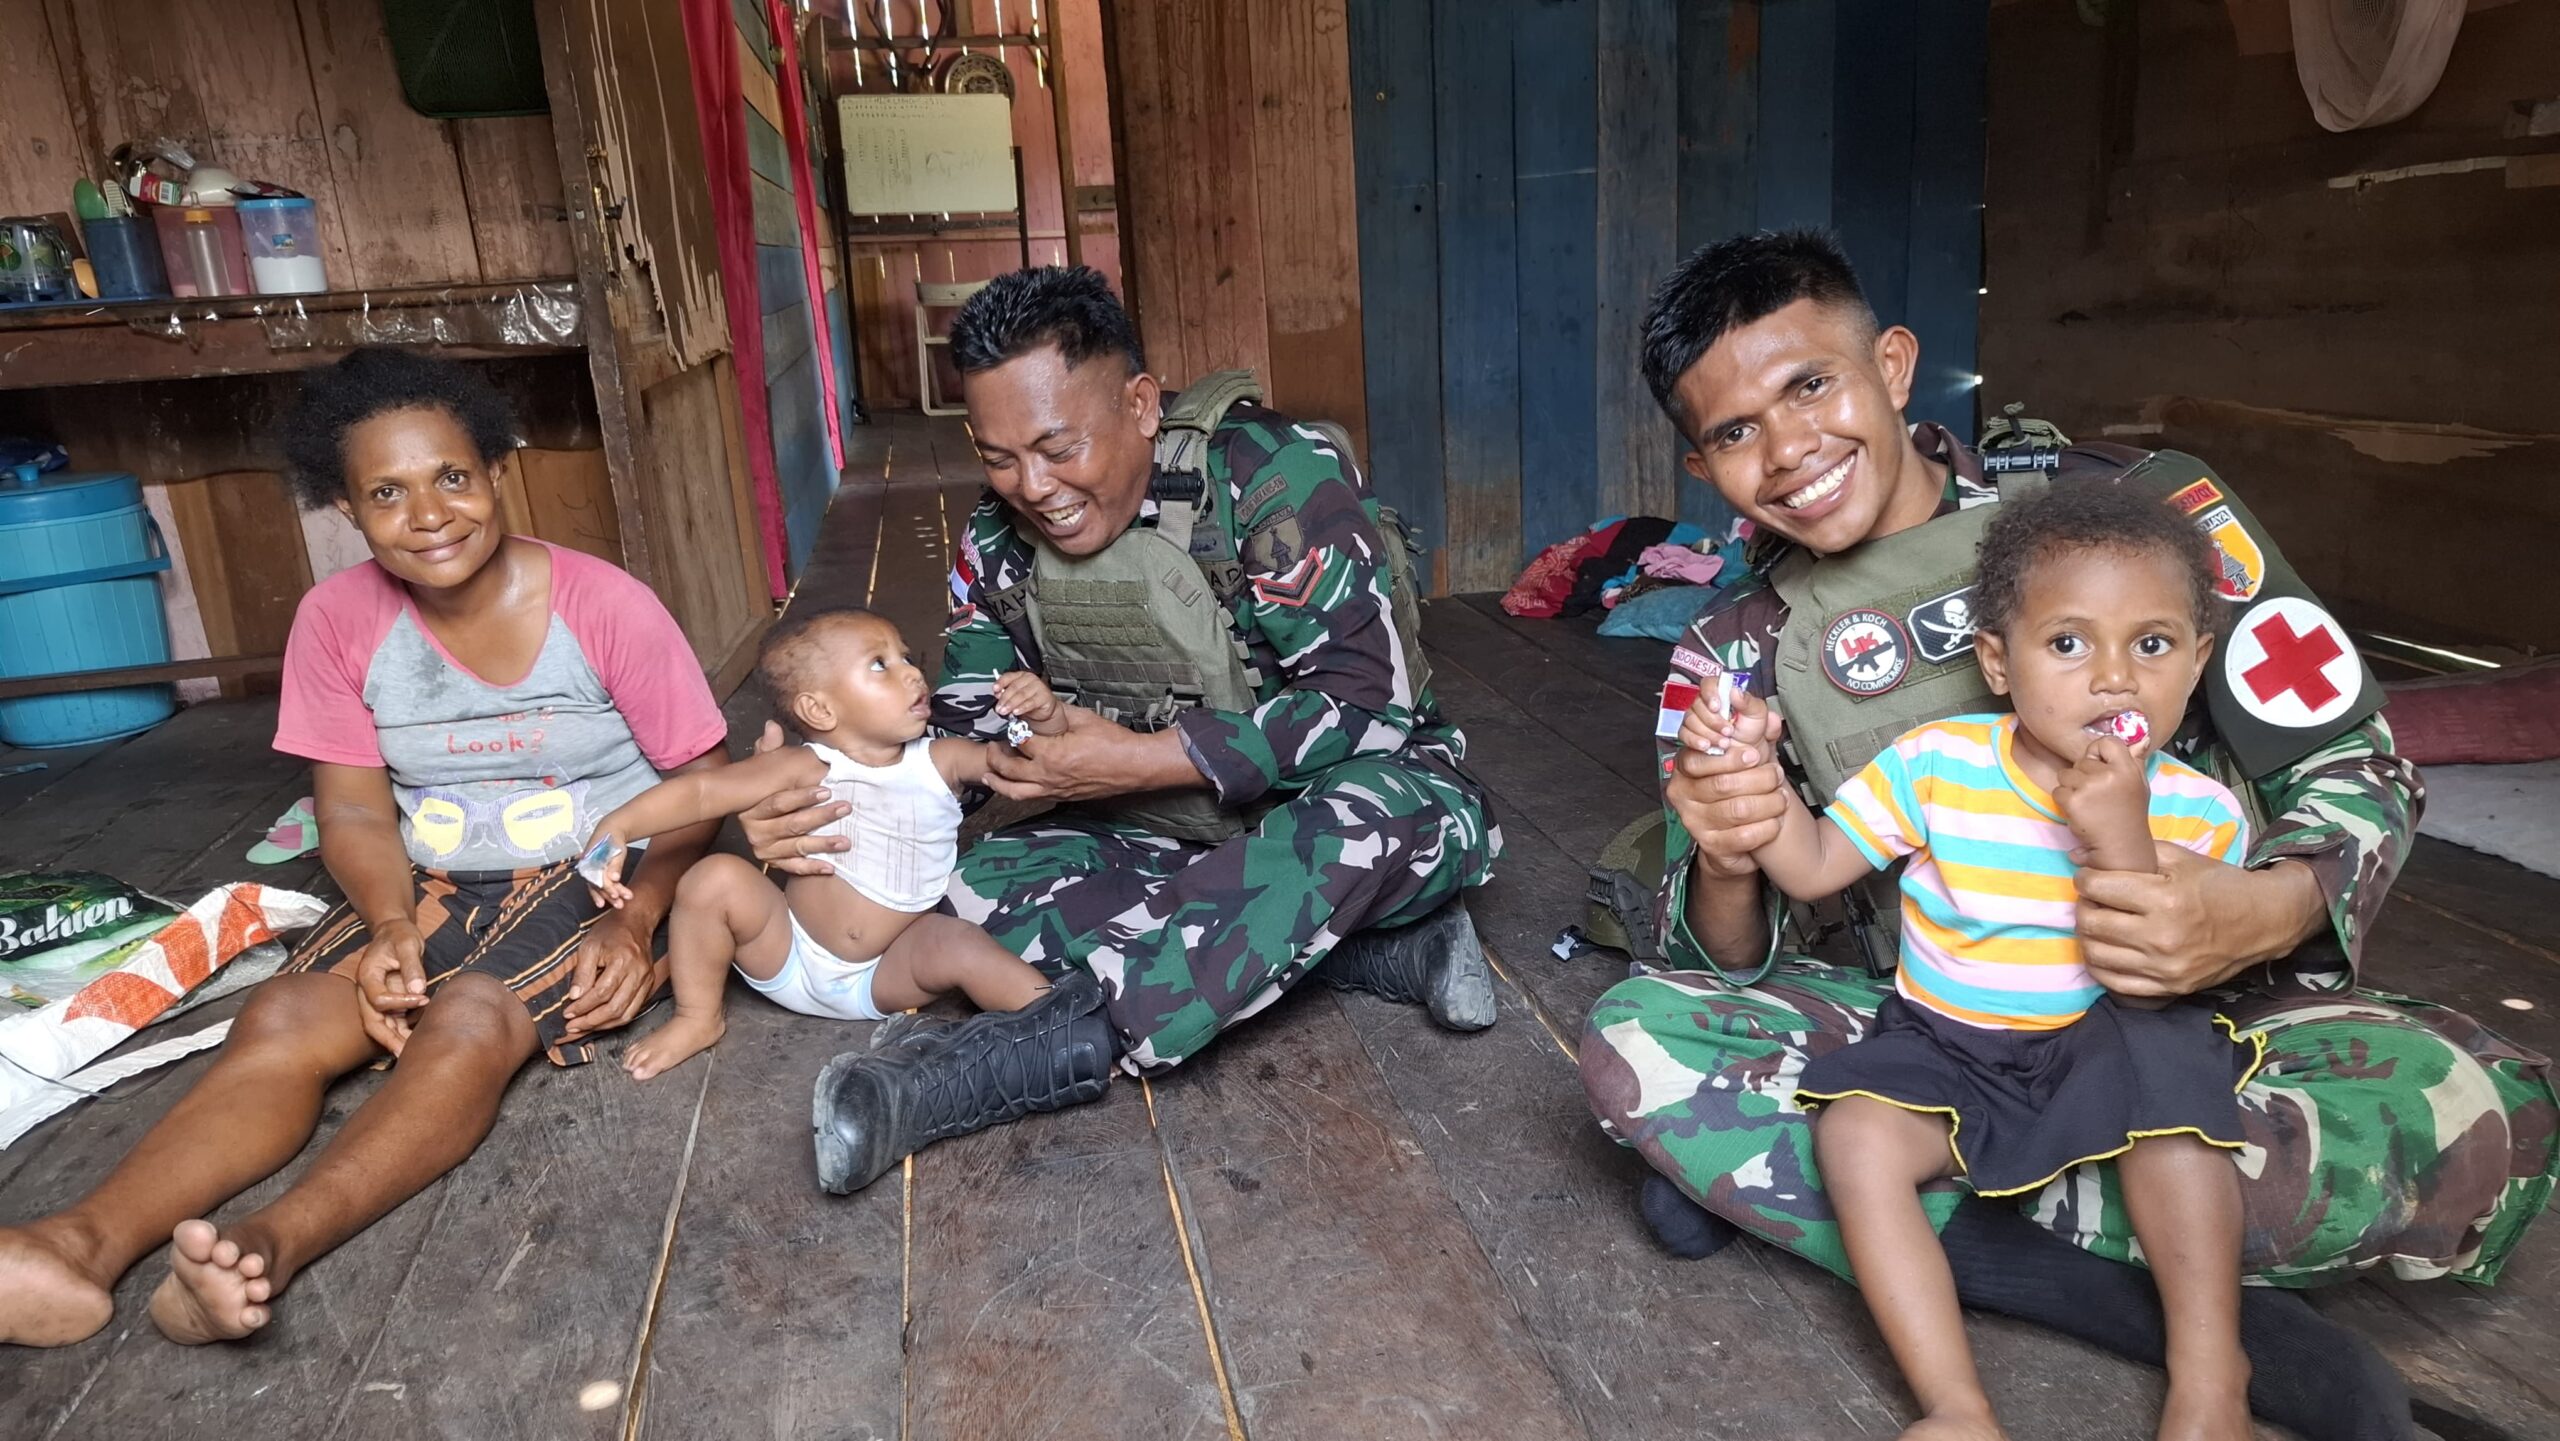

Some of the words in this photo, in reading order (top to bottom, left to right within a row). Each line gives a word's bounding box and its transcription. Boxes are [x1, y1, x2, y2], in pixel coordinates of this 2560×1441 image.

[1210, 567, 1243, 589] AD
[1825, 617, 1852, 652] HECKLER
[1851, 614, 1861, 624] &
[1862, 612, 1889, 629] KOCH
[1673, 648, 1718, 678] NDONESIA
[1846, 678, 1861, 691] NO
[1860, 656, 1905, 691] COMPROMISE
